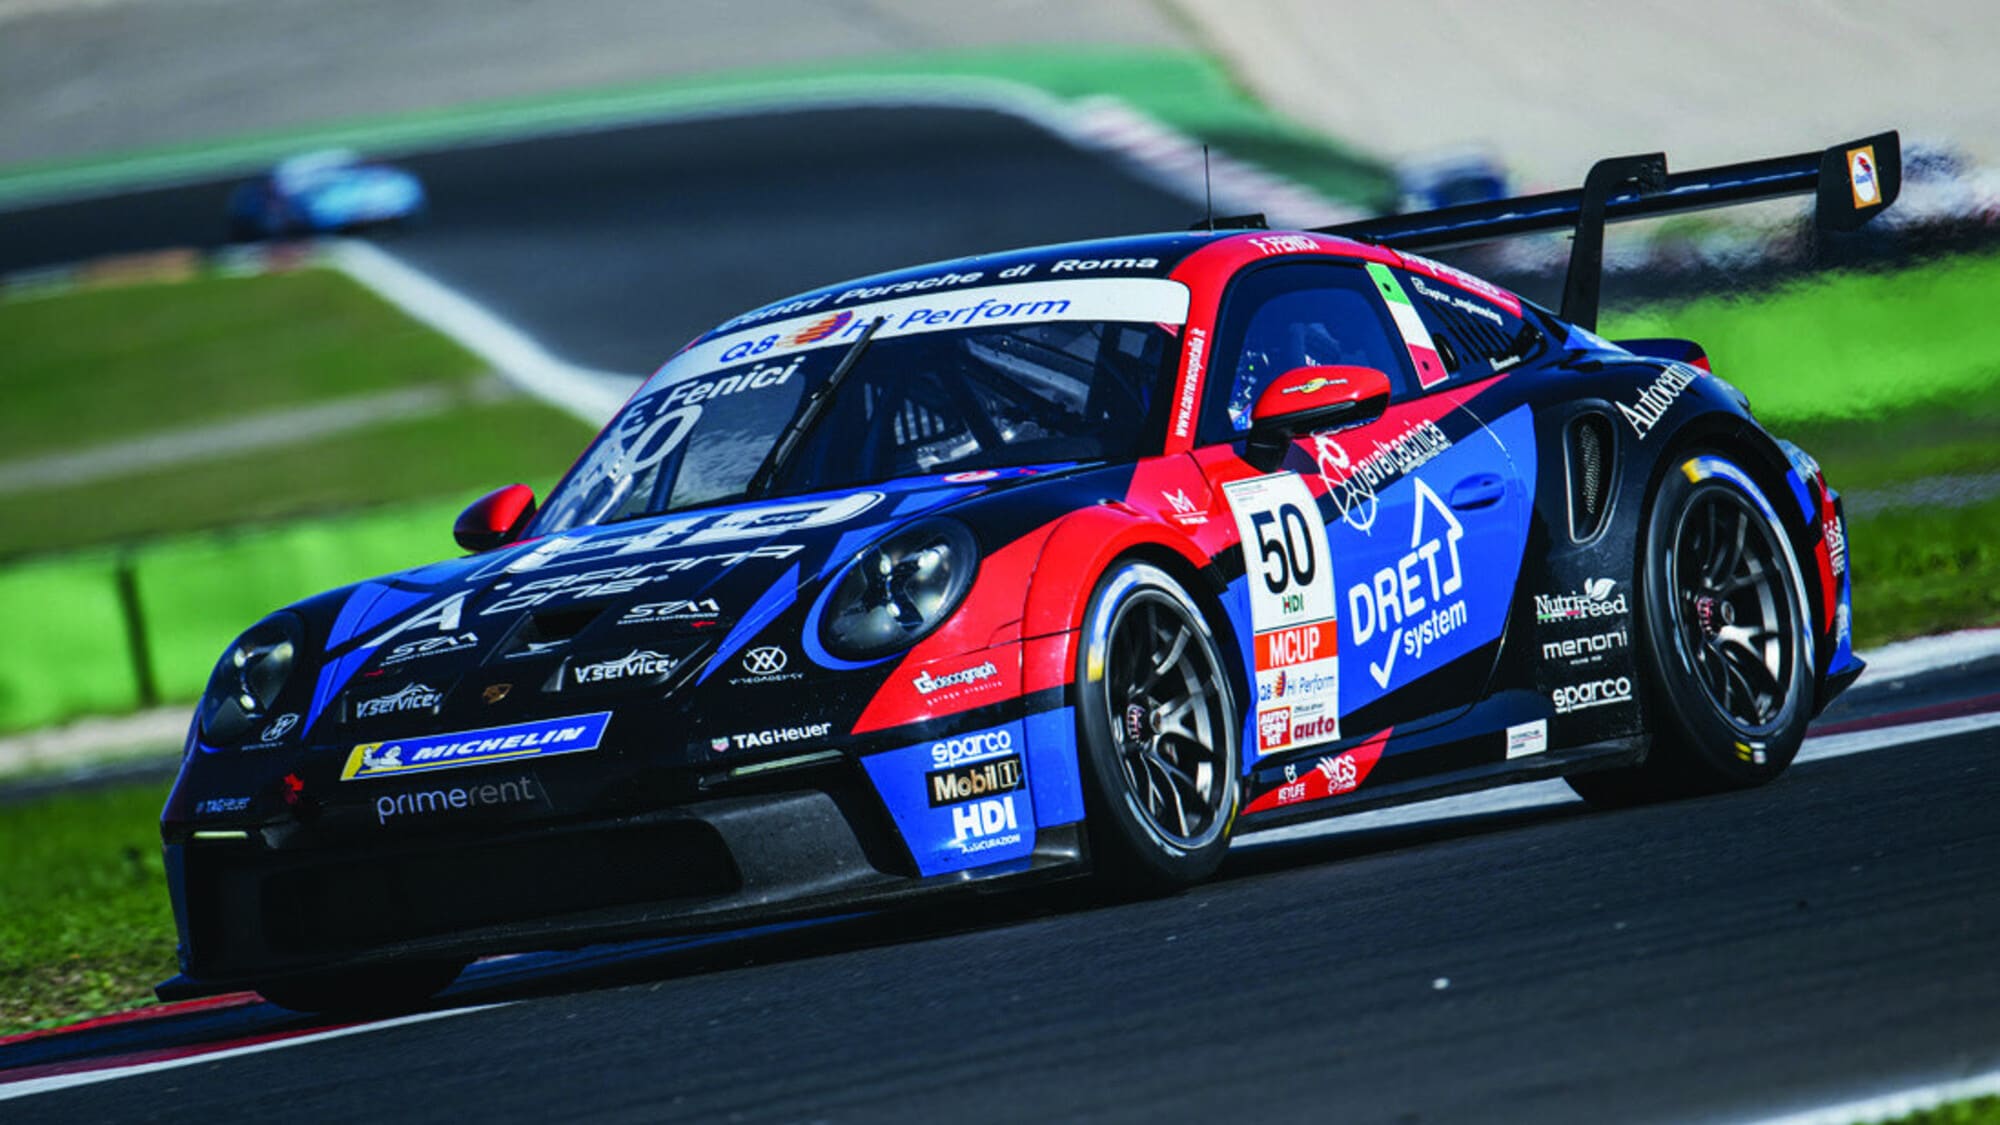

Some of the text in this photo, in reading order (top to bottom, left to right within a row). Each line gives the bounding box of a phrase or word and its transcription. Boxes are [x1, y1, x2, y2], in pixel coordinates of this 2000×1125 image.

[834, 271, 984, 304] Porsche
[998, 262, 1037, 279] di
[1050, 257, 1160, 273] Roma
[719, 298, 1071, 362] Q8 Hi Perform
[655, 355, 806, 416] Fenici
[1250, 503, 1315, 595] 50
[1283, 594, 1304, 614] HDI
[1269, 627, 1320, 667] MCUP
[1403, 600, 1467, 659] system
[1543, 626, 1628, 659] menoni
[1553, 677, 1632, 713] sparco
[411, 726, 587, 762] MICHELIN
[1294, 715, 1335, 740] auto
[931, 730, 1012, 767] sparco
[377, 776, 535, 824] primerent
[934, 764, 998, 801] Mobil
[952, 796, 1018, 841] HDI
